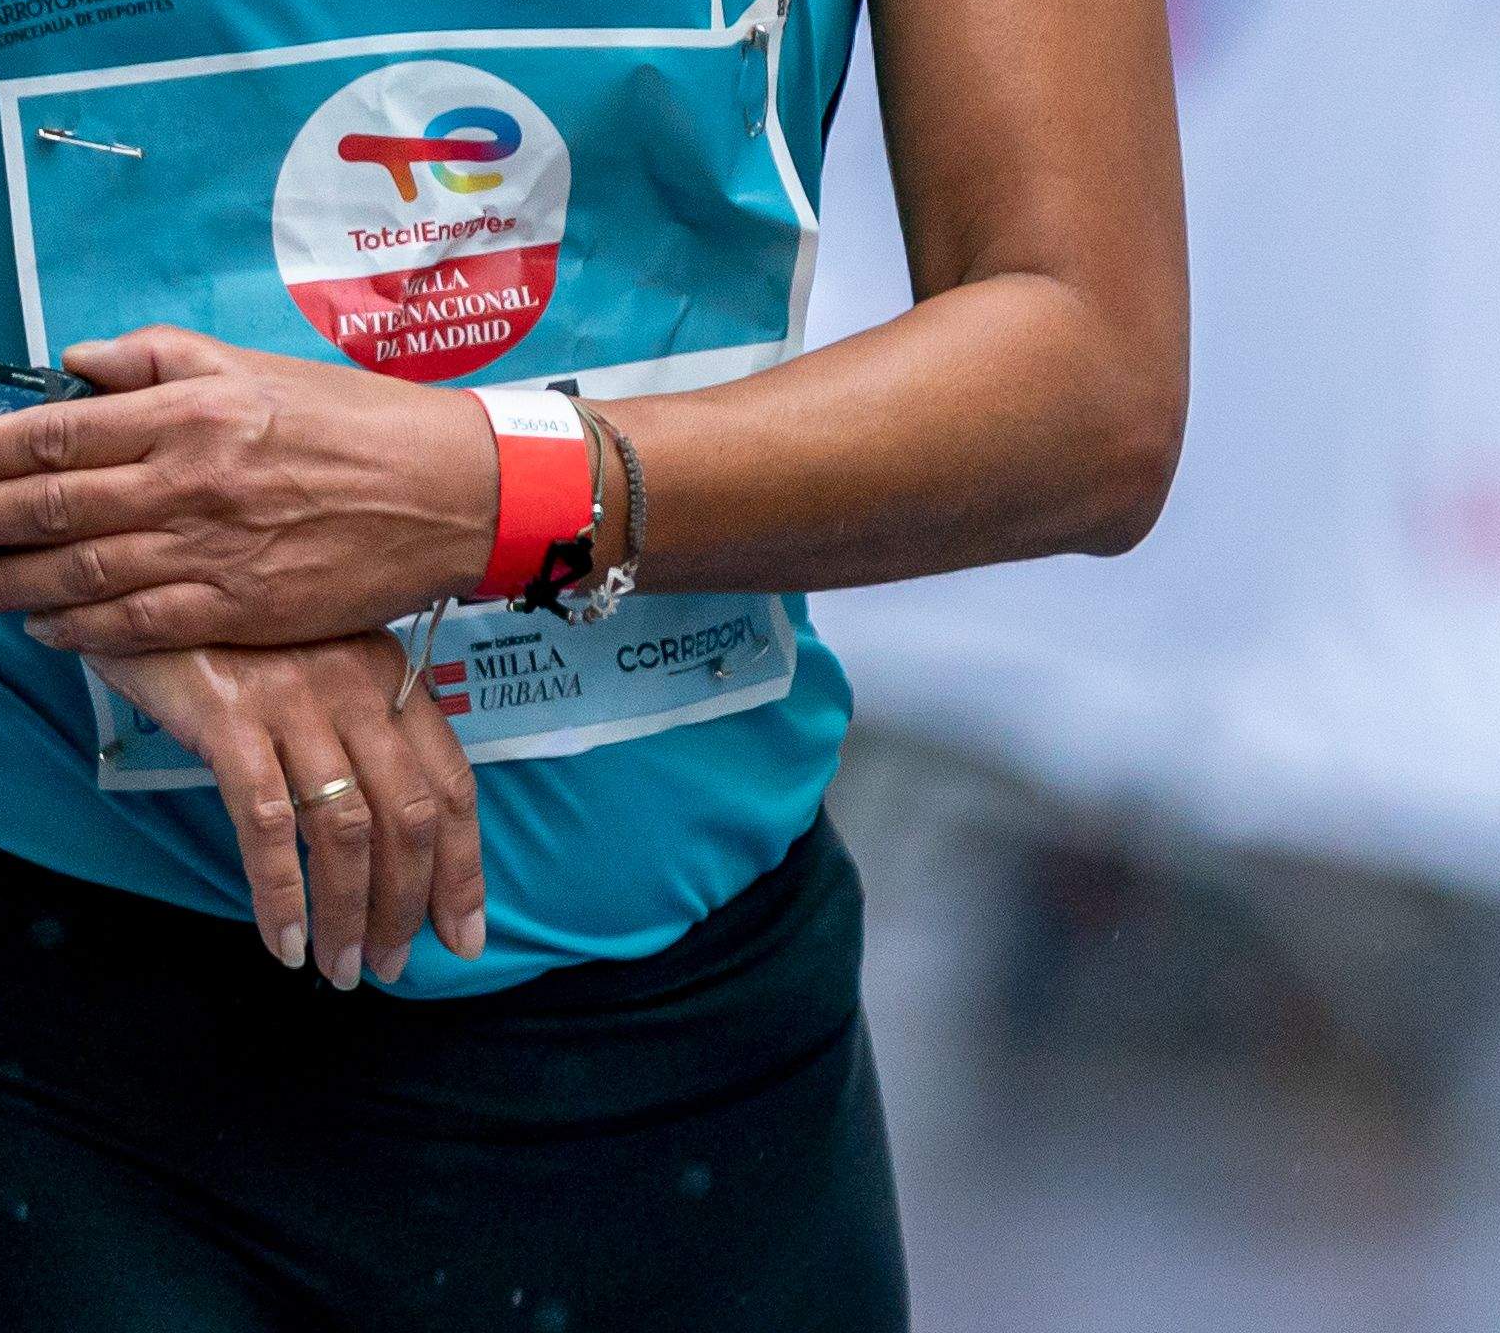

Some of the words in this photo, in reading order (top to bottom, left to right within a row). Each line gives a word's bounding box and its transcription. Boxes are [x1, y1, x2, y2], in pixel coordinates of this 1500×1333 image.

[75, 10, 95, 28] DE
[348, 207, 517, 252] TotalEnergies
[405, 320, 512, 355] MADRID
[474, 645, 566, 680] MILLA
[480, 671, 584, 711] URBANA
